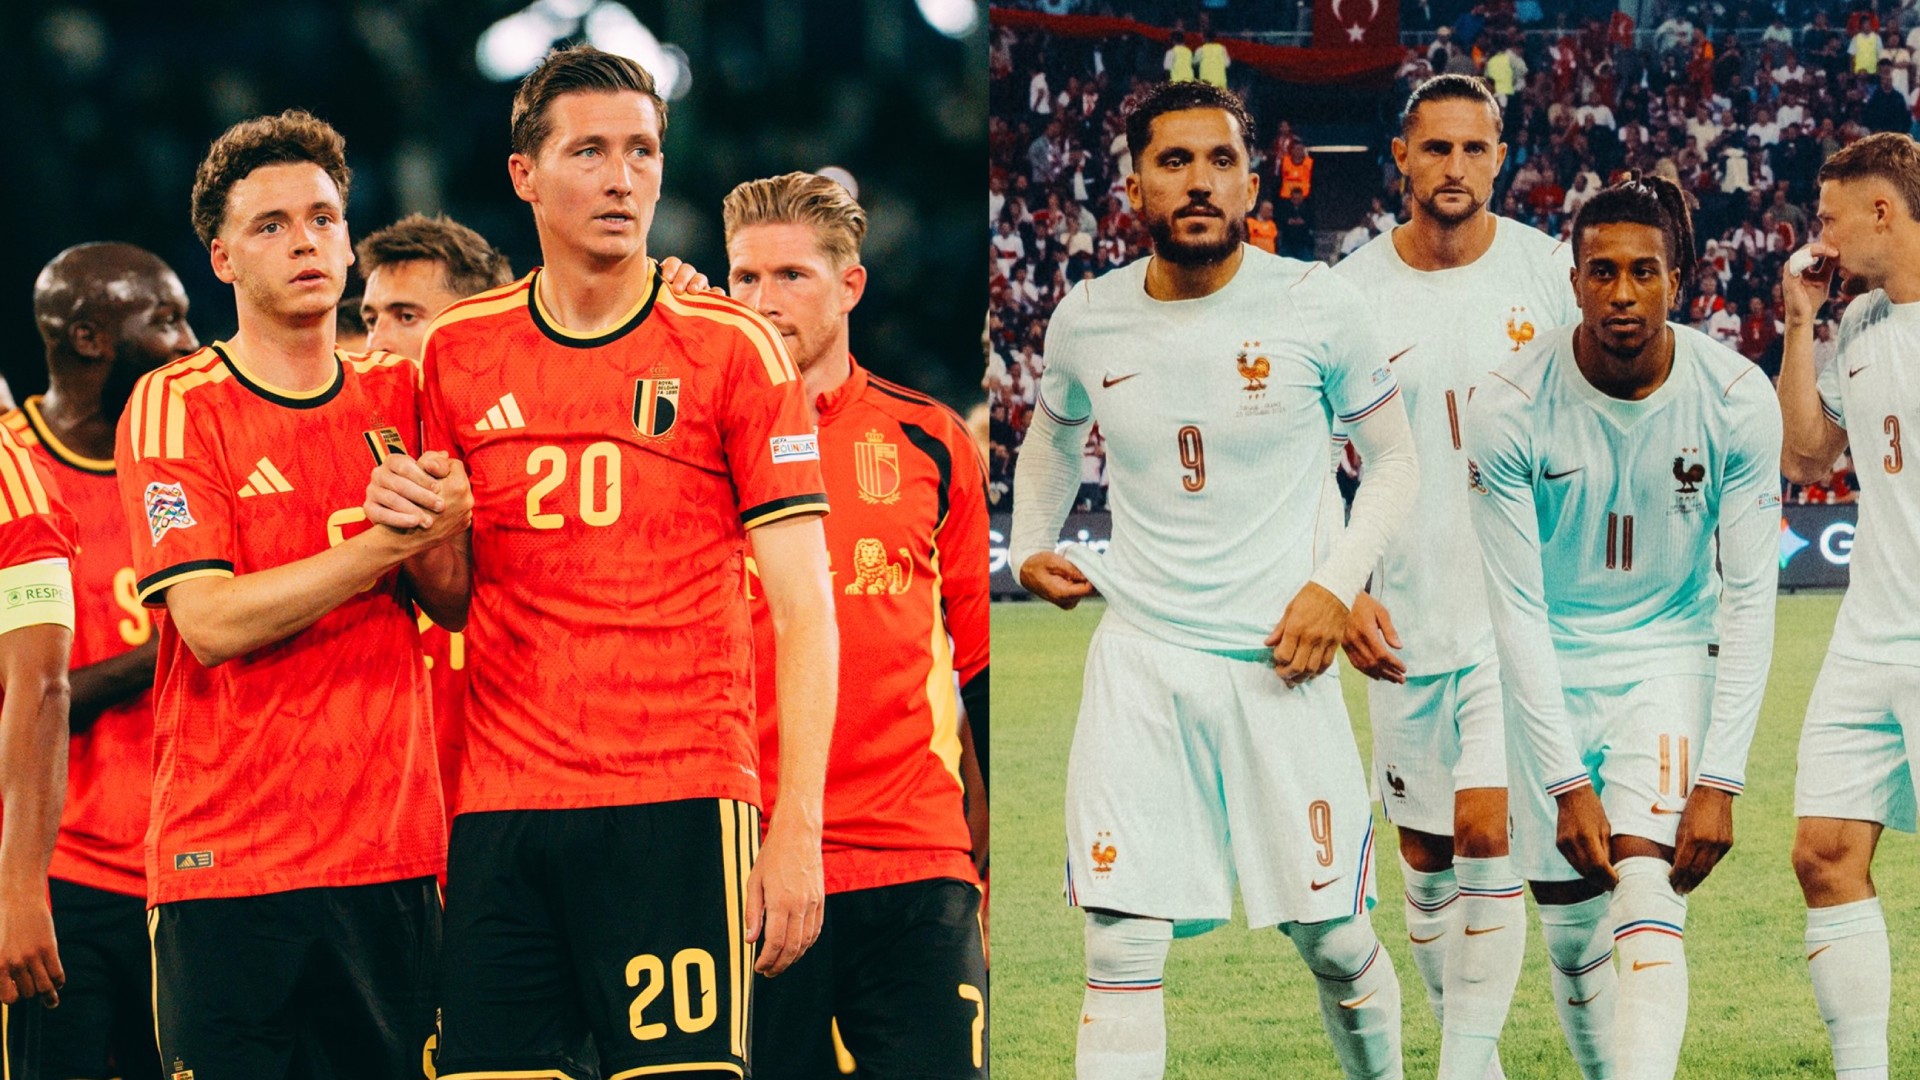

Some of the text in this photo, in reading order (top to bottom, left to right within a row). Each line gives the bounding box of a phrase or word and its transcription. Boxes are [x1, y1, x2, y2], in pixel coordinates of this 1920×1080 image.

[1177, 425, 1206, 492] 9
[1883, 414, 1903, 474] 3
[526, 441, 622, 530] 20
[1605, 510, 1634, 572] 11
[1659, 734, 1689, 799] 11
[1309, 800, 1334, 867] 9
[625, 947, 718, 1041] 20
[958, 983, 985, 1069] 7
